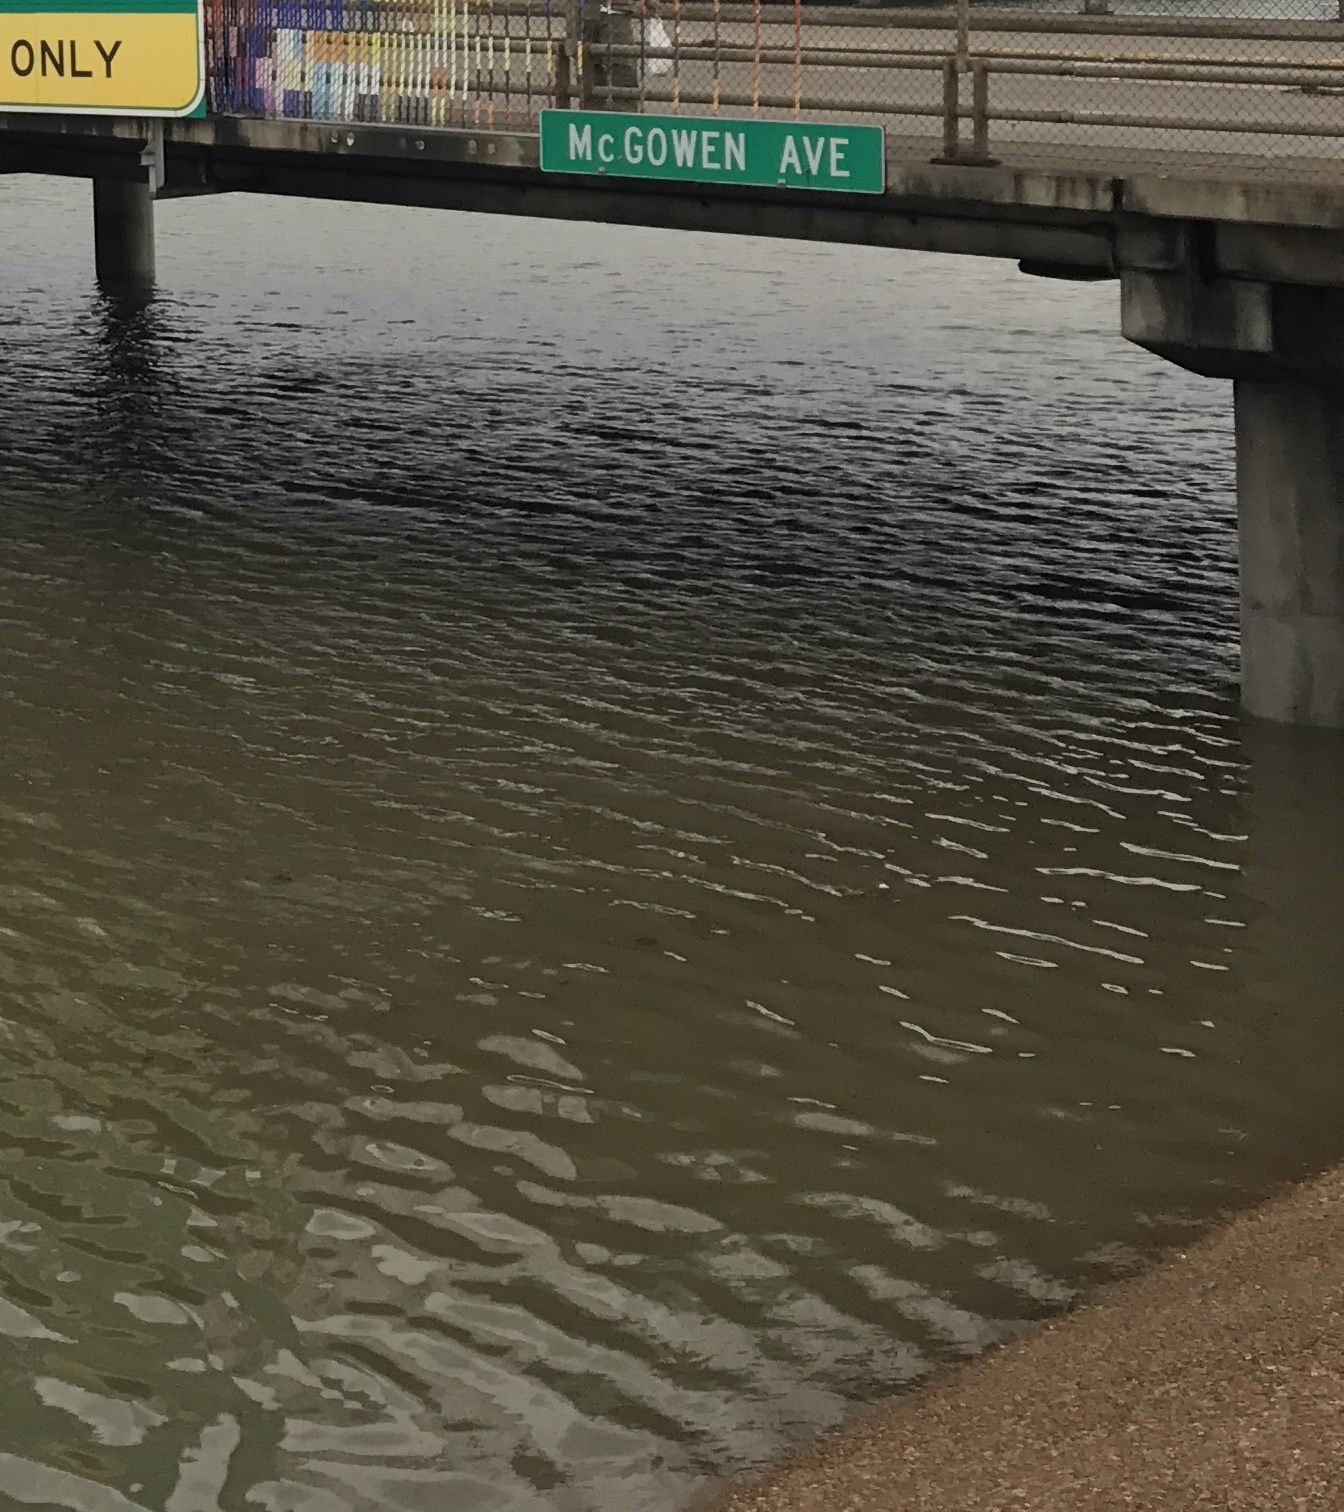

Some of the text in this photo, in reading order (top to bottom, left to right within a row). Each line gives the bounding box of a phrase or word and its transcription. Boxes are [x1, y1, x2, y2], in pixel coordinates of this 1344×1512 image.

[10, 39, 122, 78] ONLY
[568, 122, 851, 178] McGOWEN AVE
